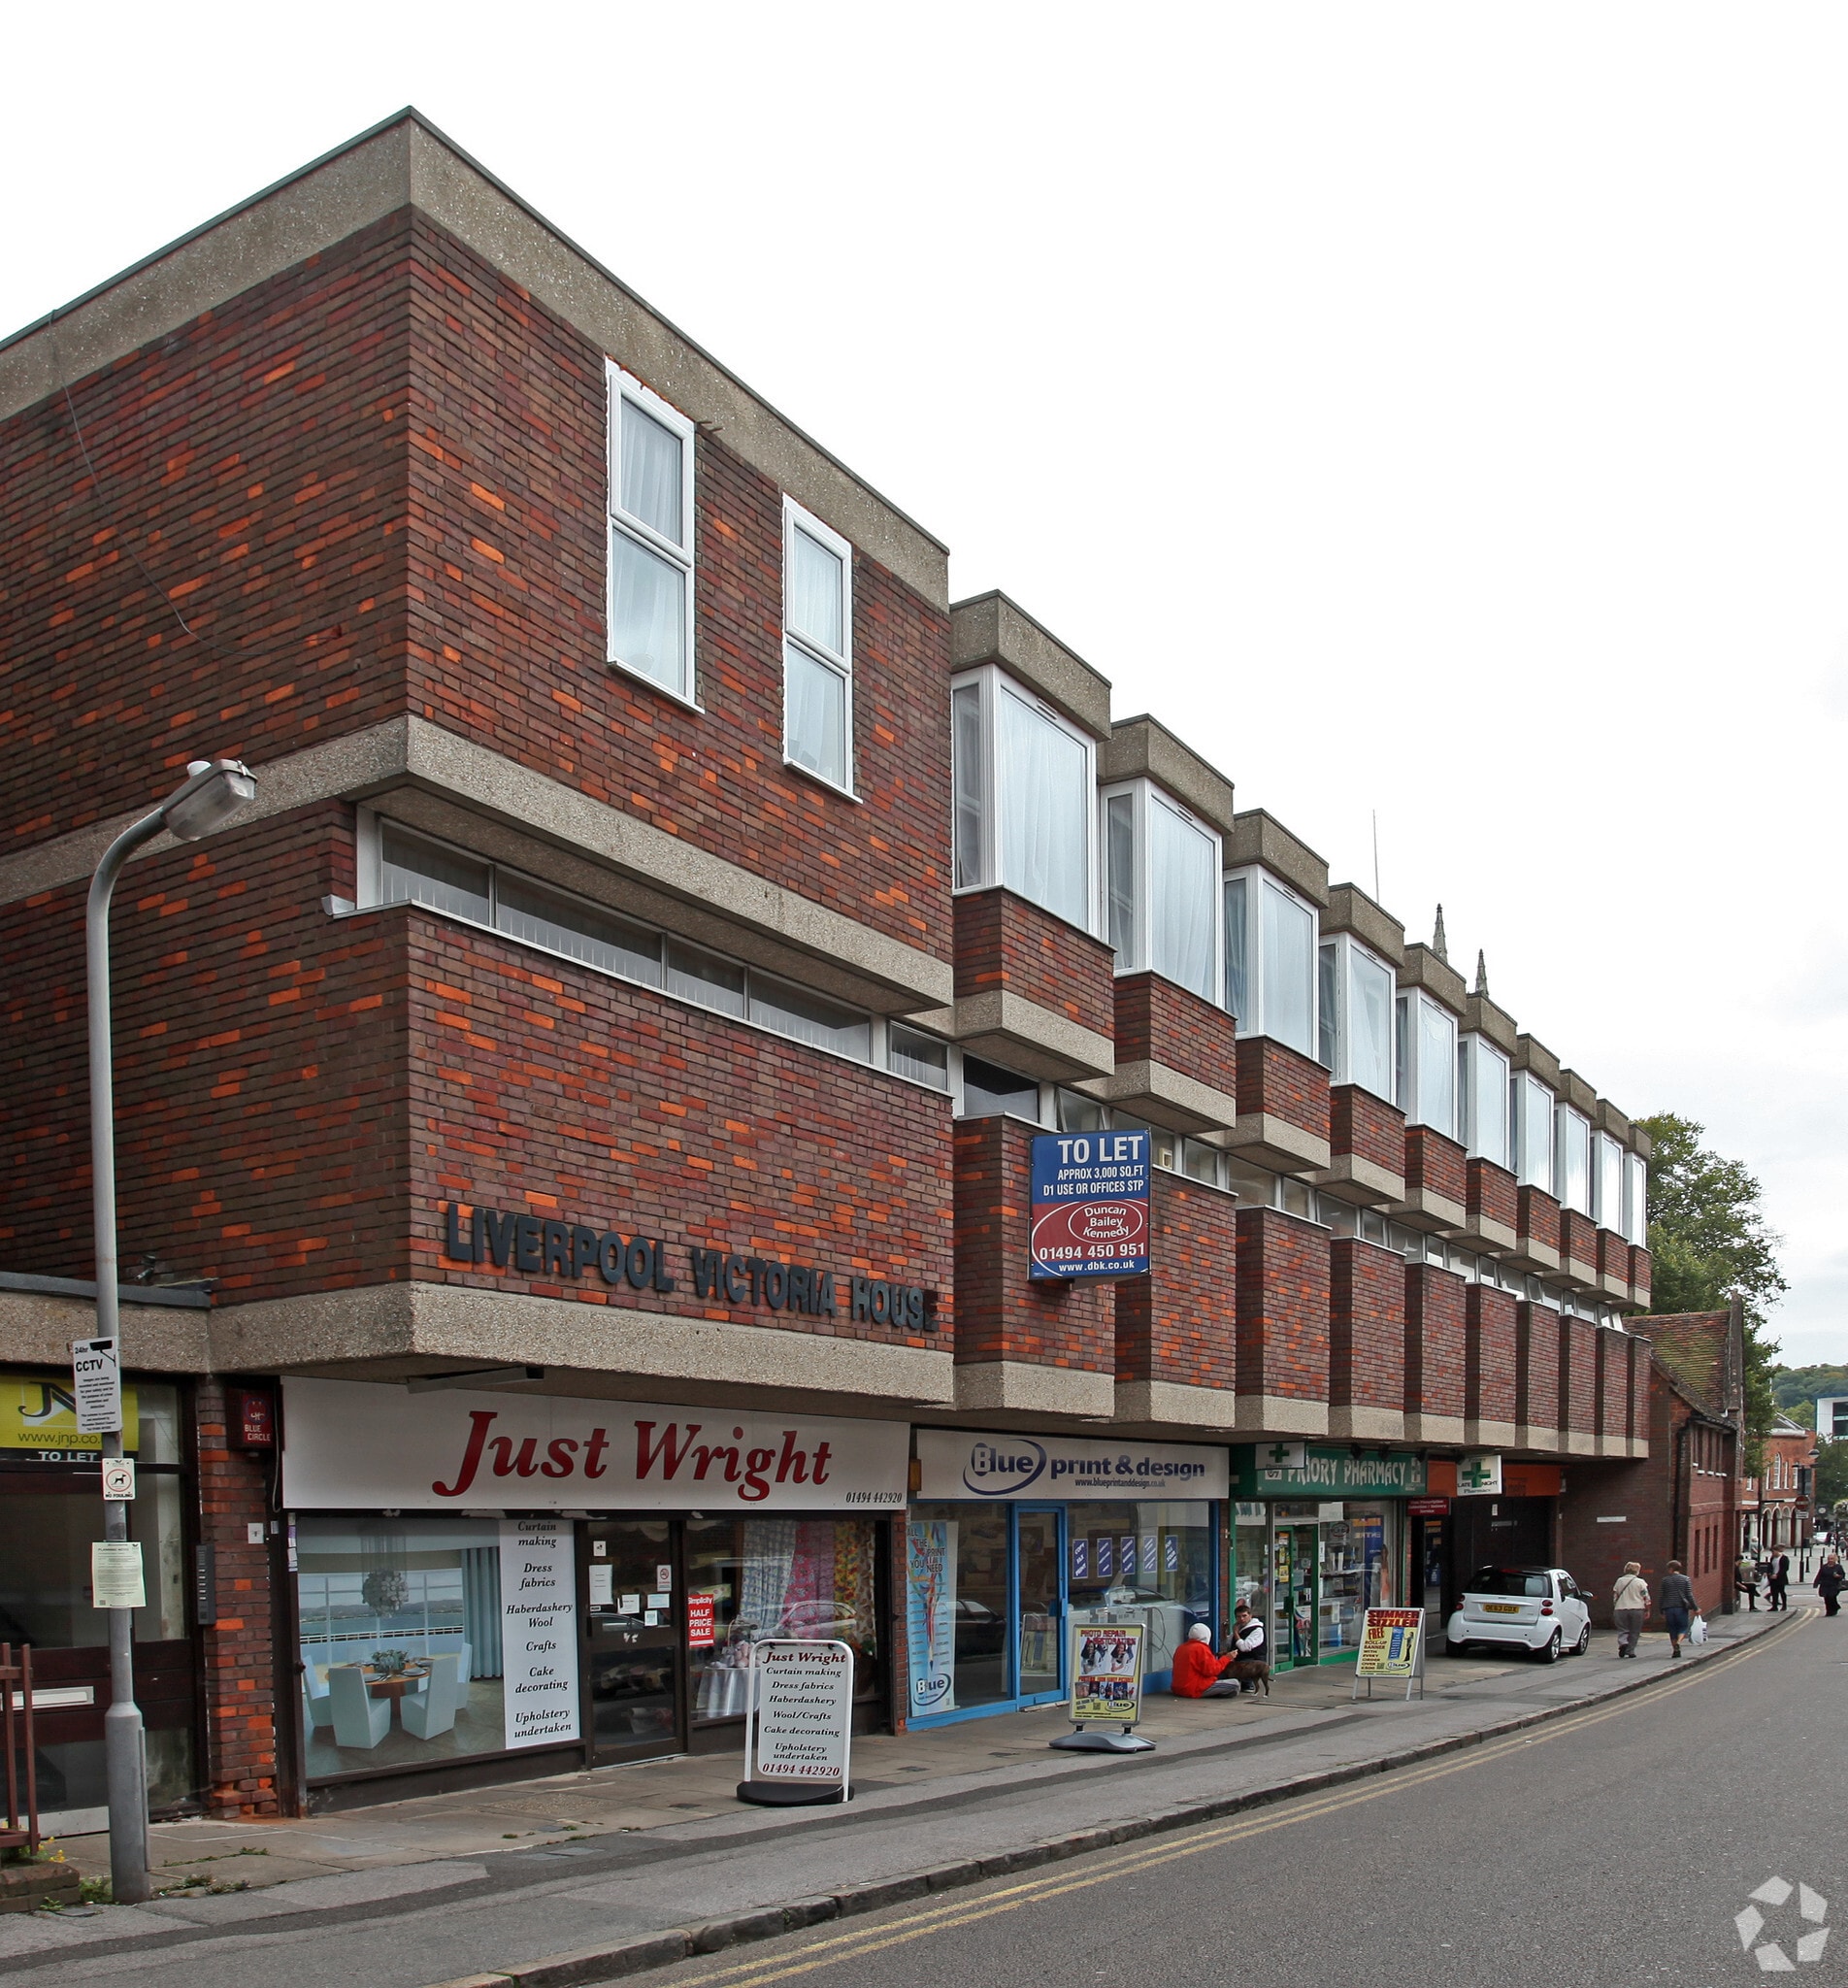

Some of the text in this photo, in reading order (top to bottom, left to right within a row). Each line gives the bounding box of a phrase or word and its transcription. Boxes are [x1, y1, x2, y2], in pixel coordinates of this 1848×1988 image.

[1057, 1135, 1143, 1164] TO LET
[1057, 1165, 1144, 1180] APPROX 3,000 SQ.FT
[1043, 1179, 1144, 1196] D1 USE OR OFFICES STP
[1083, 1206, 1127, 1217] Duncan
[1090, 1216, 1124, 1228] Bailey
[1083, 1226, 1130, 1238] Kennedy
[1040, 1242, 1144, 1260] 01494 450 951
[446, 1202, 676, 1291] LIVERPOOL
[690, 1246, 839, 1318] VICTORIA
[1059, 1260, 1135, 1273] www.dbk.co.uk
[76, 1359, 103, 1372] CCTV
[17, 1432, 101, 1445] www.jnp.co.
[247, 1433, 271, 1441] CIRCLE
[39, 1451, 98, 1462] TO LET
[431, 1409, 833, 1502] Just Wright
[973, 1443, 1205, 1481] Blue print & design
[1343, 1459, 1406, 1487] PHARMACY
[1074, 1477, 1166, 1489] www.blueprintanddesign.co.uk
[845, 1491, 903, 1504] 01494 442920
[517, 1521, 557, 1532] Curtain
[517, 1536, 557, 1548] making
[915, 1538, 928, 1547] THE
[523, 1562, 553, 1573] Dress
[926, 1563, 943, 1573] NEED
[518, 1577, 556, 1591] fabrics
[506, 1603, 573, 1615] Haberdashery
[690, 1608, 710, 1617] HALF
[1368, 1609, 1420, 1618] SUMMER
[528, 1616, 553, 1628] Wool
[688, 1618, 711, 1627] PRICE
[1368, 1618, 1419, 1627] SIZZLER
[690, 1628, 711, 1637] SALE
[1368, 1627, 1385, 1640] FREE
[525, 1640, 557, 1653] Crafts
[762, 1651, 846, 1666] Just Wright
[529, 1666, 554, 1677] Cake
[766, 1666, 842, 1678] Curtain making
[514, 1679, 569, 1694] decorating
[772, 1680, 835, 1691] Dress fabrics
[916, 1678, 945, 1695] Blue
[769, 1695, 837, 1706] Haberdashery
[515, 1709, 571, 1725] Upholstery
[773, 1710, 832, 1721] Wool/Crafts
[513, 1722, 572, 1739] undertaken
[764, 1725, 841, 1738] Cake decorating
[775, 1742, 827, 1753] Upholstery
[773, 1751, 828, 1761] undertaken
[762, 1763, 841, 1776] 01494 442920
